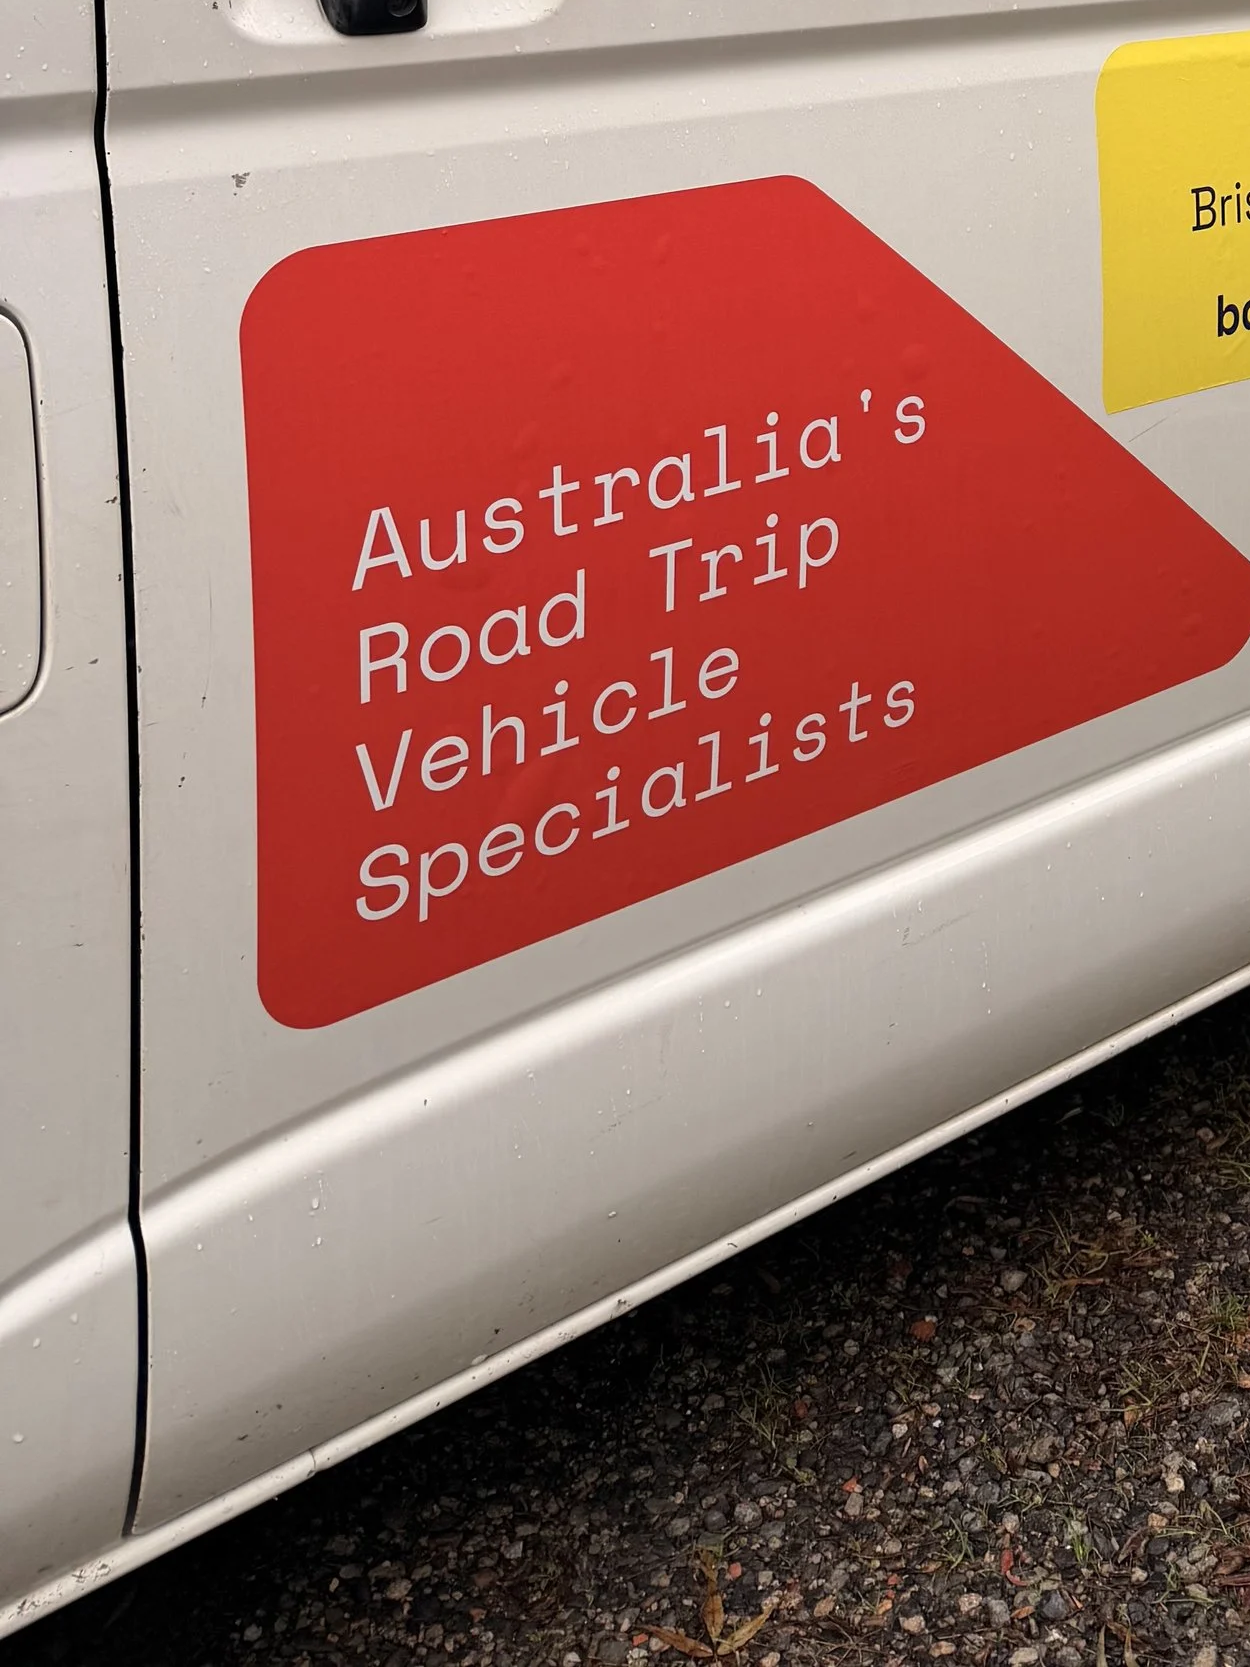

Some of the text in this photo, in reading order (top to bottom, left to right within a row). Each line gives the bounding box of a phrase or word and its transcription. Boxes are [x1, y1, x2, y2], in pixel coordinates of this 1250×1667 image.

[350, 388, 928, 591] Australia's
[355, 513, 841, 705] Road Trip
[354, 647, 740, 813] Vehicle
[354, 679, 917, 924] Specialists
